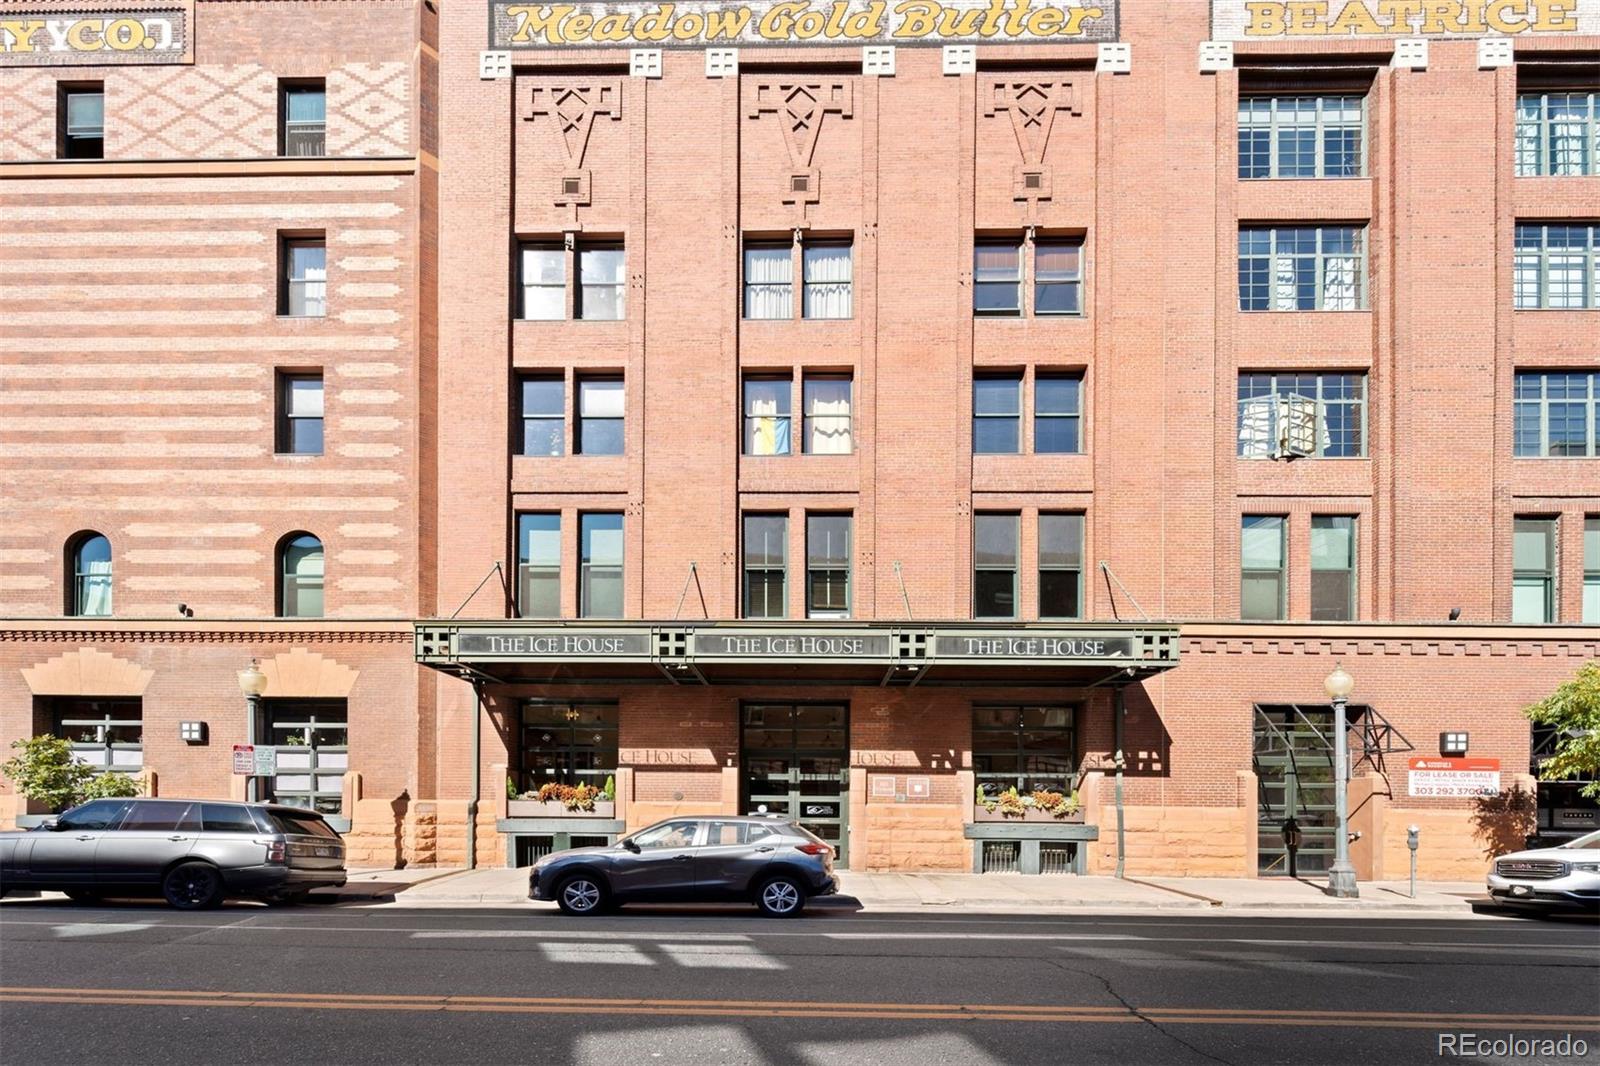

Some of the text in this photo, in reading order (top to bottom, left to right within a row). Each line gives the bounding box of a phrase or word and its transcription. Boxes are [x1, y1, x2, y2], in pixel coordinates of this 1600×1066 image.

[506, 0, 1104, 44] Meadow Gold Butter
[1243, 0, 1578, 35] BEATRICE
[486, 636, 625, 653] THE ICE HOUSE
[722, 636, 864, 654] THE ICE HOUSE
[964, 637, 1105, 656] THE ICE HOUSE
[1414, 787, 1434, 795] 303
[1436, 787, 1454, 795] 292
